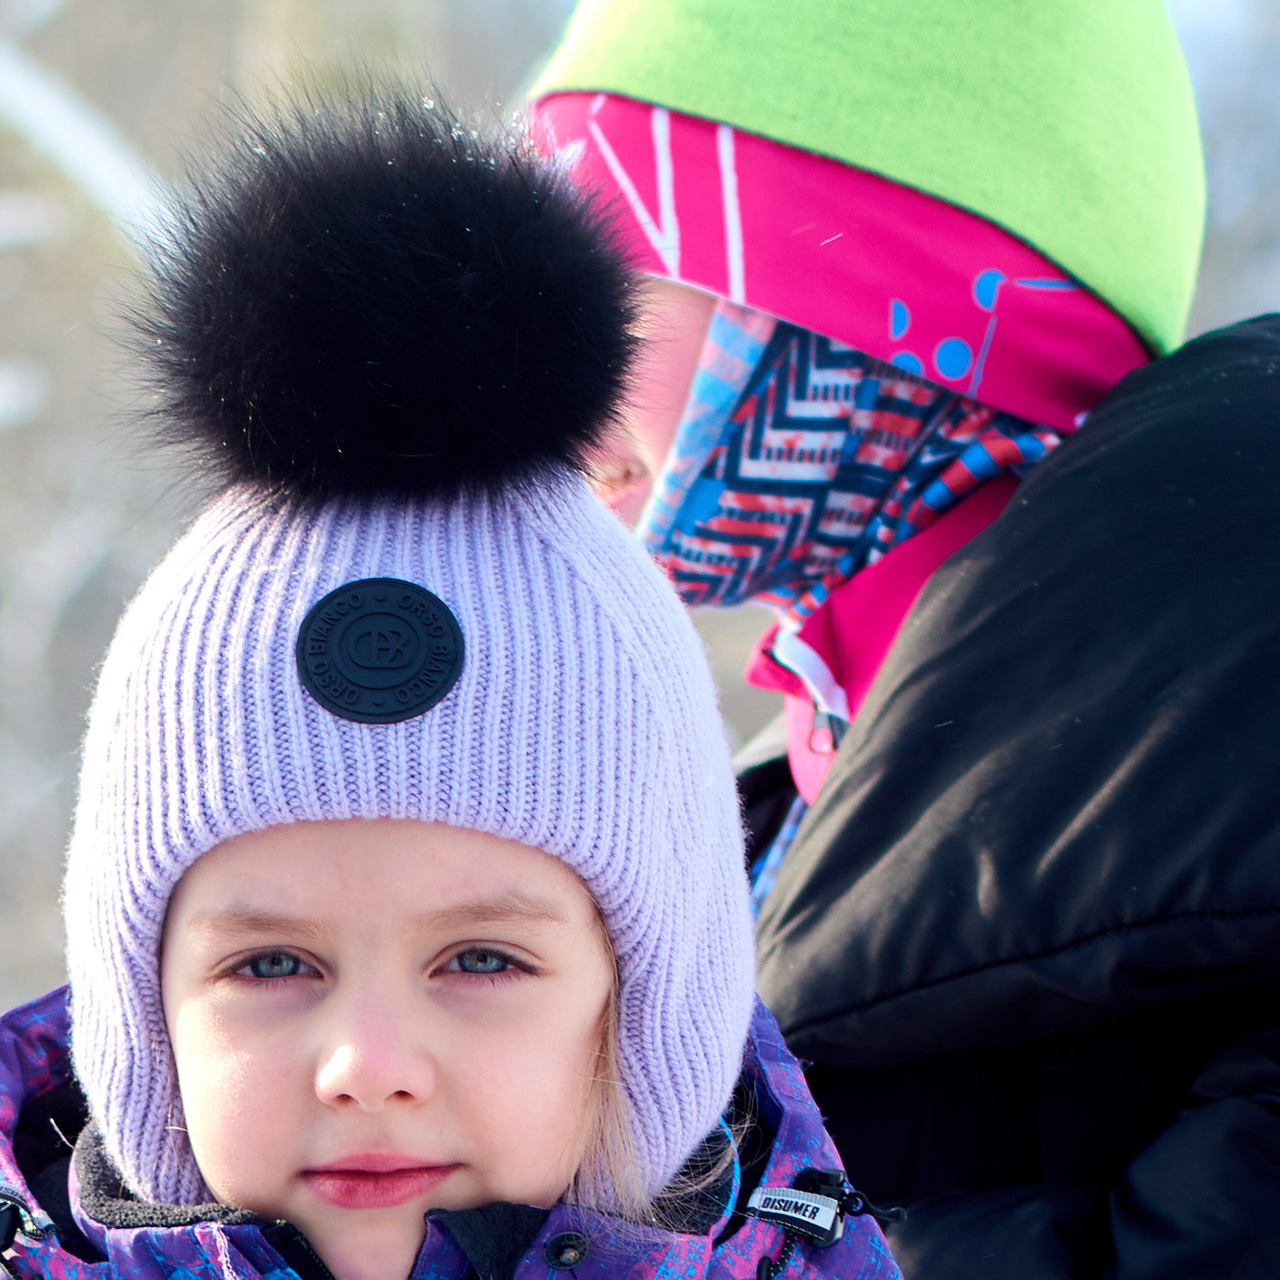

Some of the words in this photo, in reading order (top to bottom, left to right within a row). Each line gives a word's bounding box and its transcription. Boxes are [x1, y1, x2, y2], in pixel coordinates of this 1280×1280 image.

[308, 594, 363, 656] BIANCO
[399, 594, 446, 638] ORSO
[312, 661, 360, 705] ORSO
[396, 644, 451, 704] BIANCO
